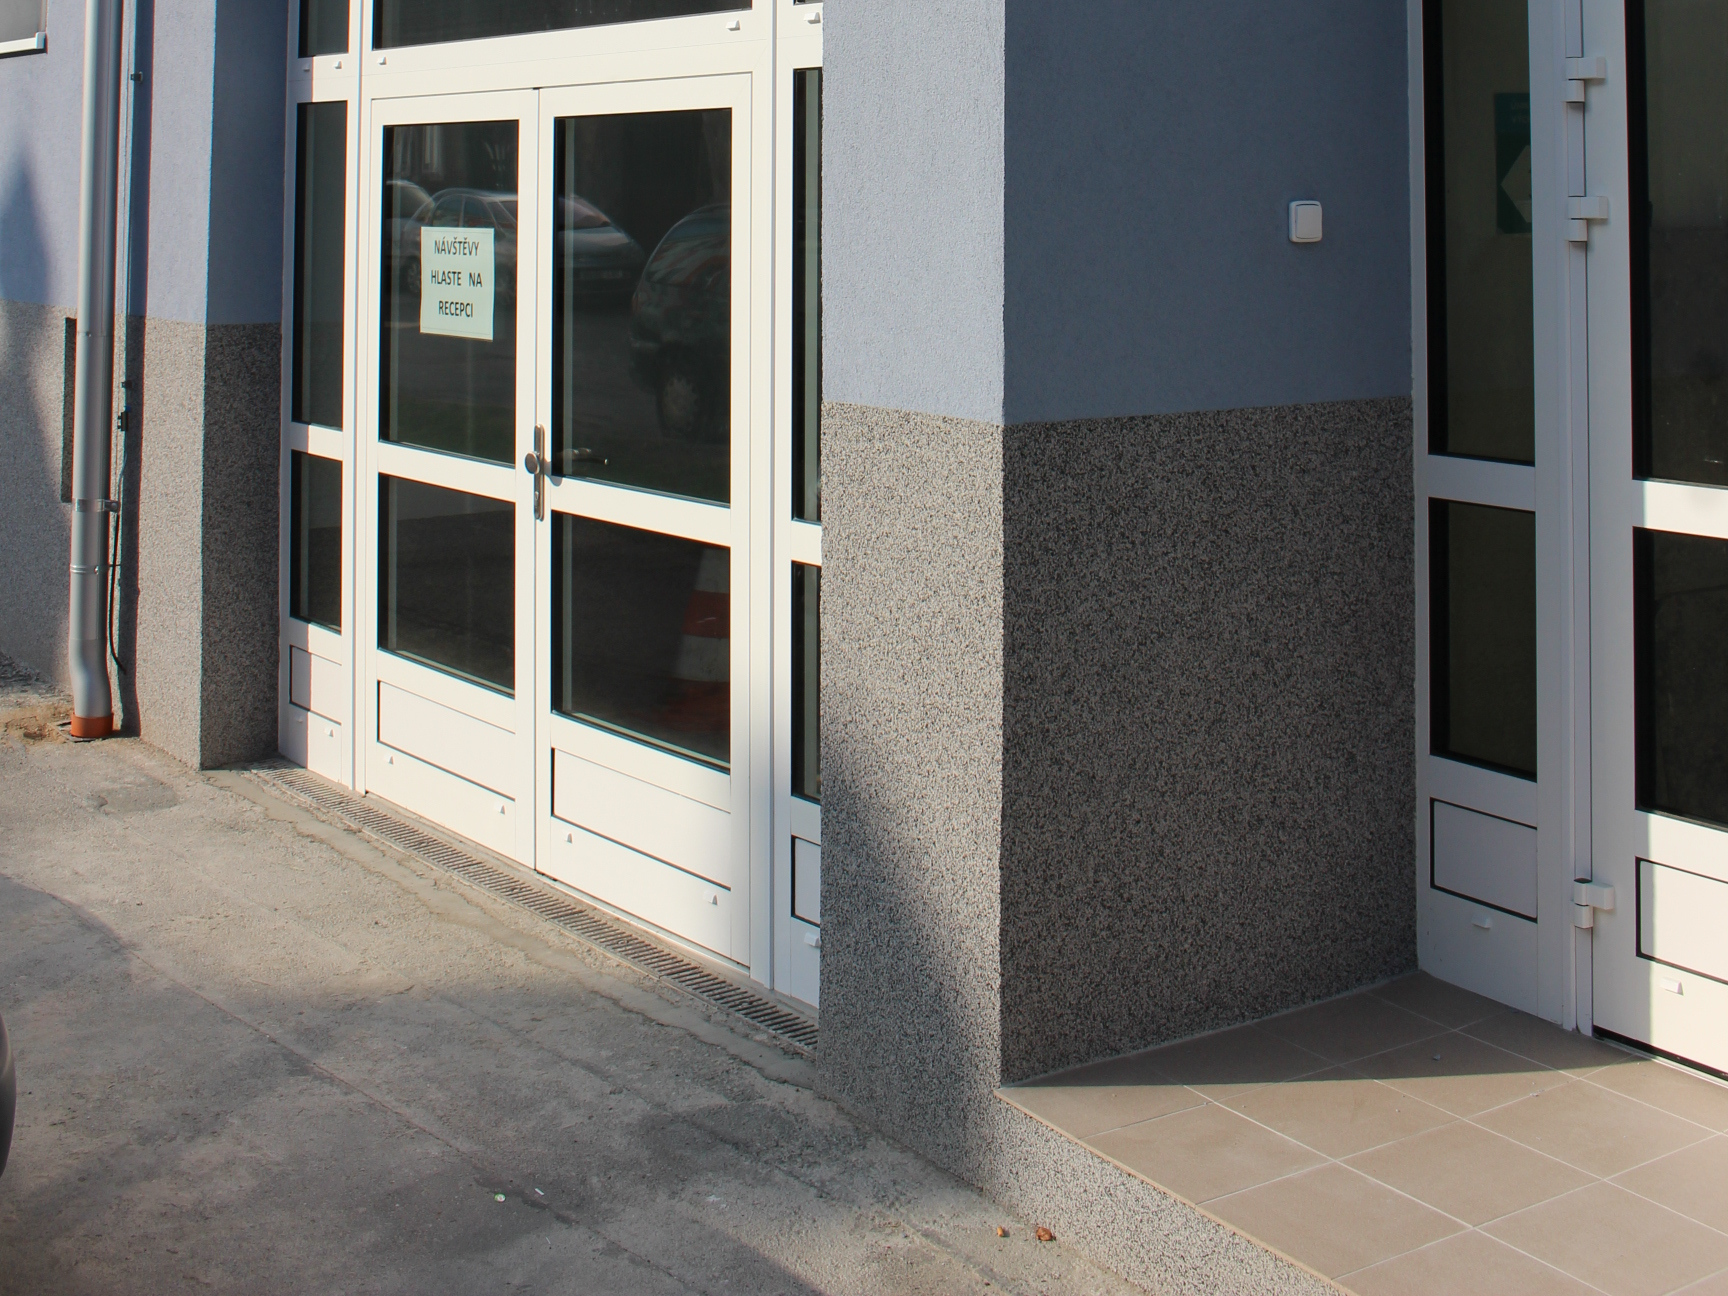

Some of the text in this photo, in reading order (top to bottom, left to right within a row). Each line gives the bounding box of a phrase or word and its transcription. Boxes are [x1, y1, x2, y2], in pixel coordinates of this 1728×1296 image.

[434, 236, 479, 256] NÁVŠTĚVY
[431, 269, 482, 287] HLASTE NA
[438, 300, 473, 318] RECEPCI
